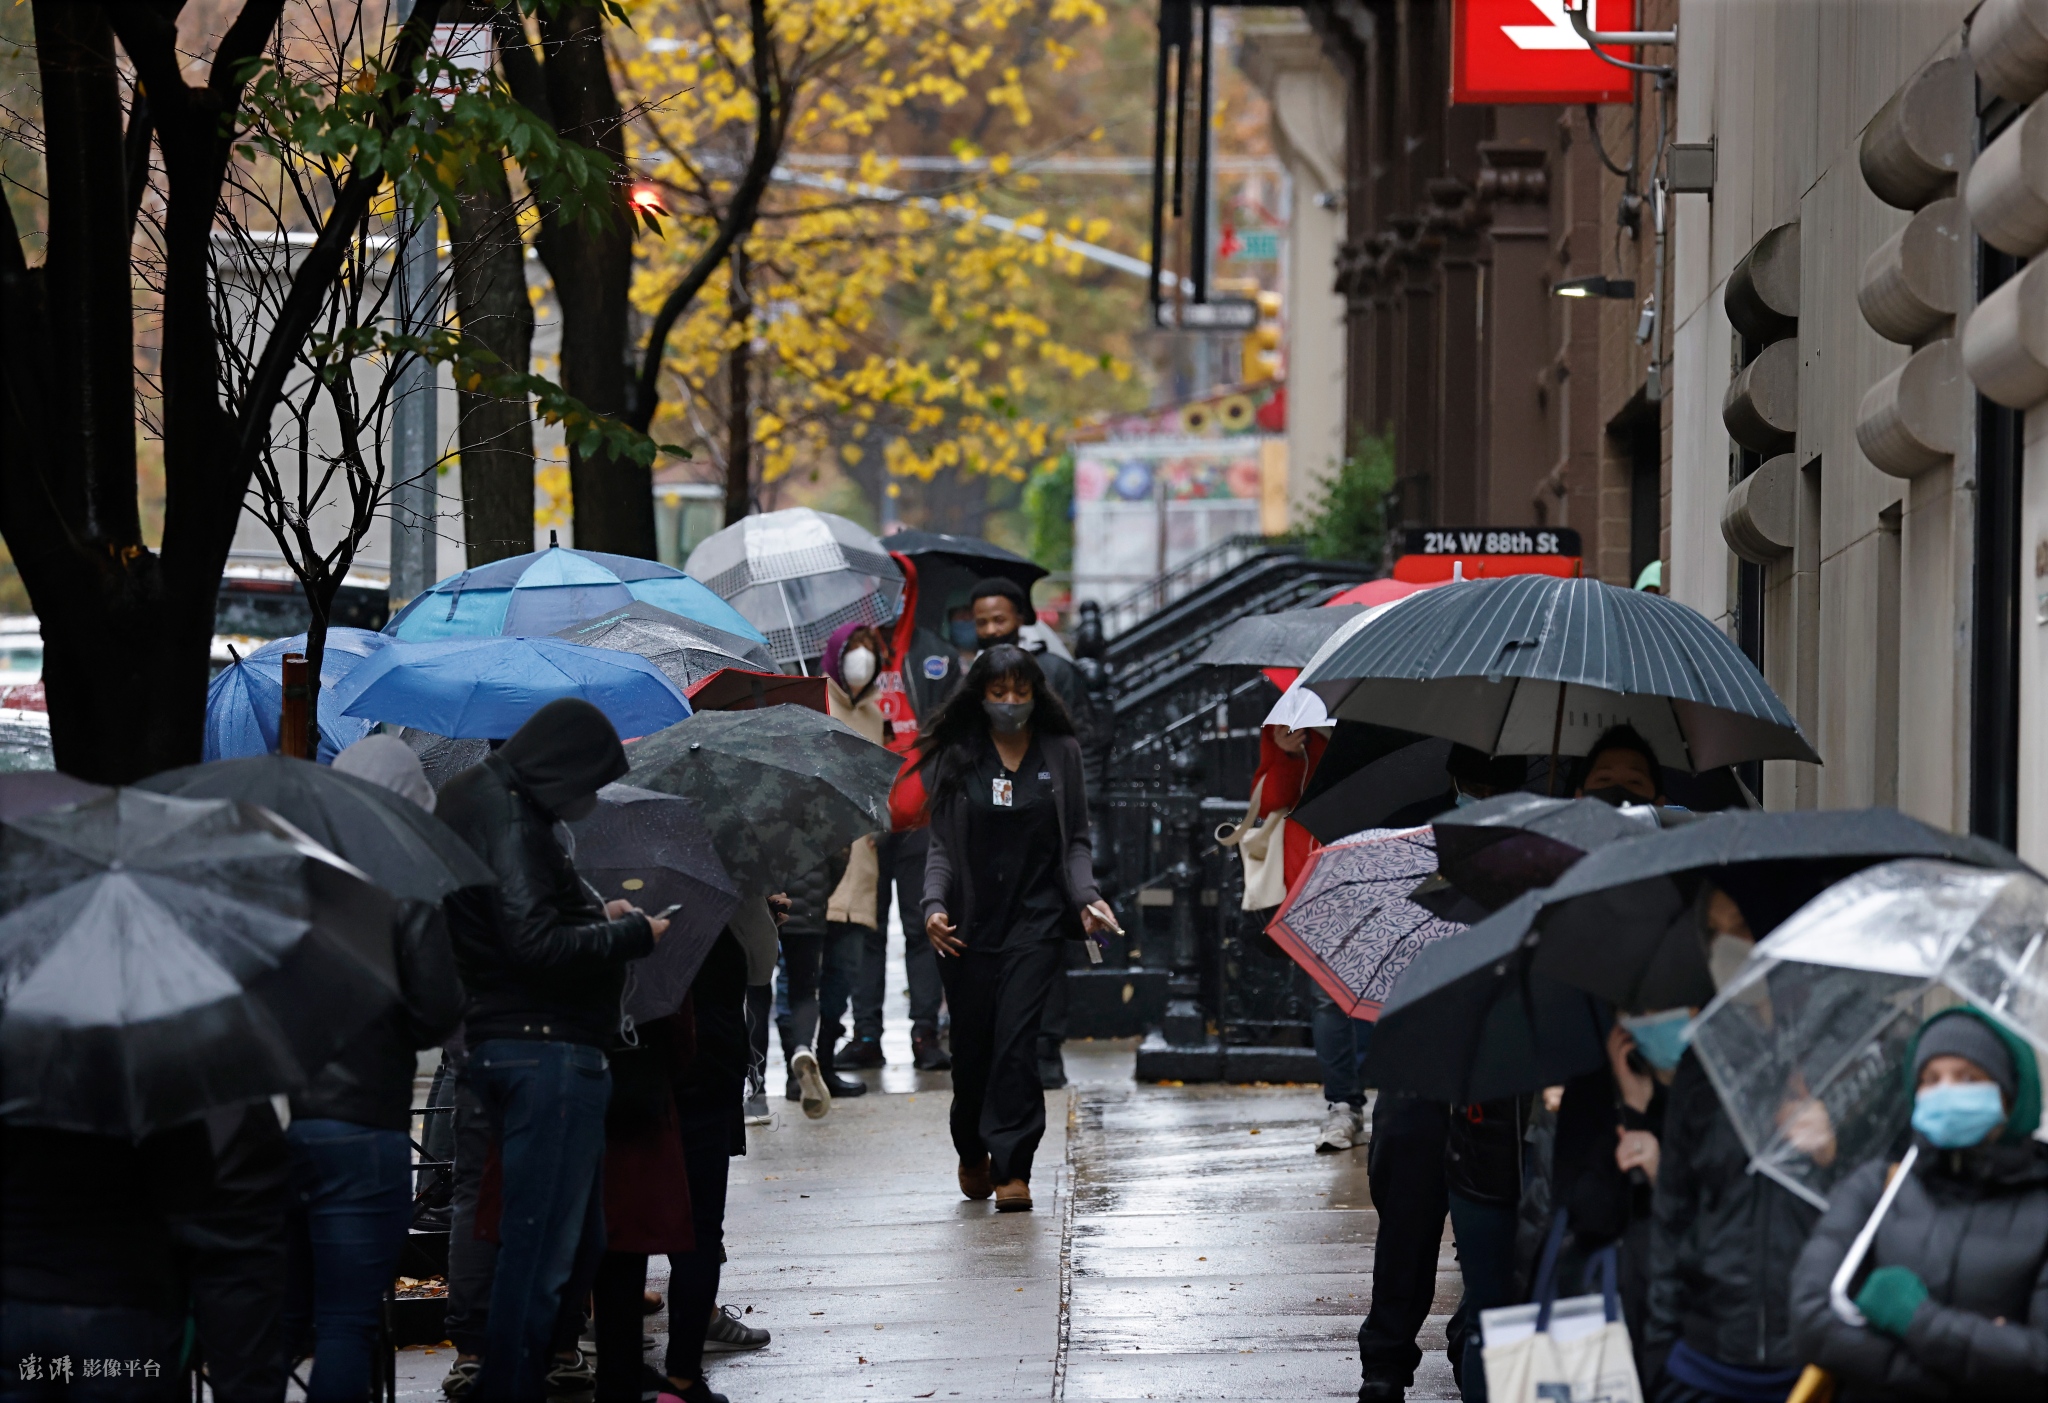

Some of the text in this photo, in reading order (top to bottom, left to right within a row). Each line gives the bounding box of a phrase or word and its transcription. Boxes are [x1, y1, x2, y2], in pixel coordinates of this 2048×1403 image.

[1424, 532, 1560, 553] 214 W 88th St
